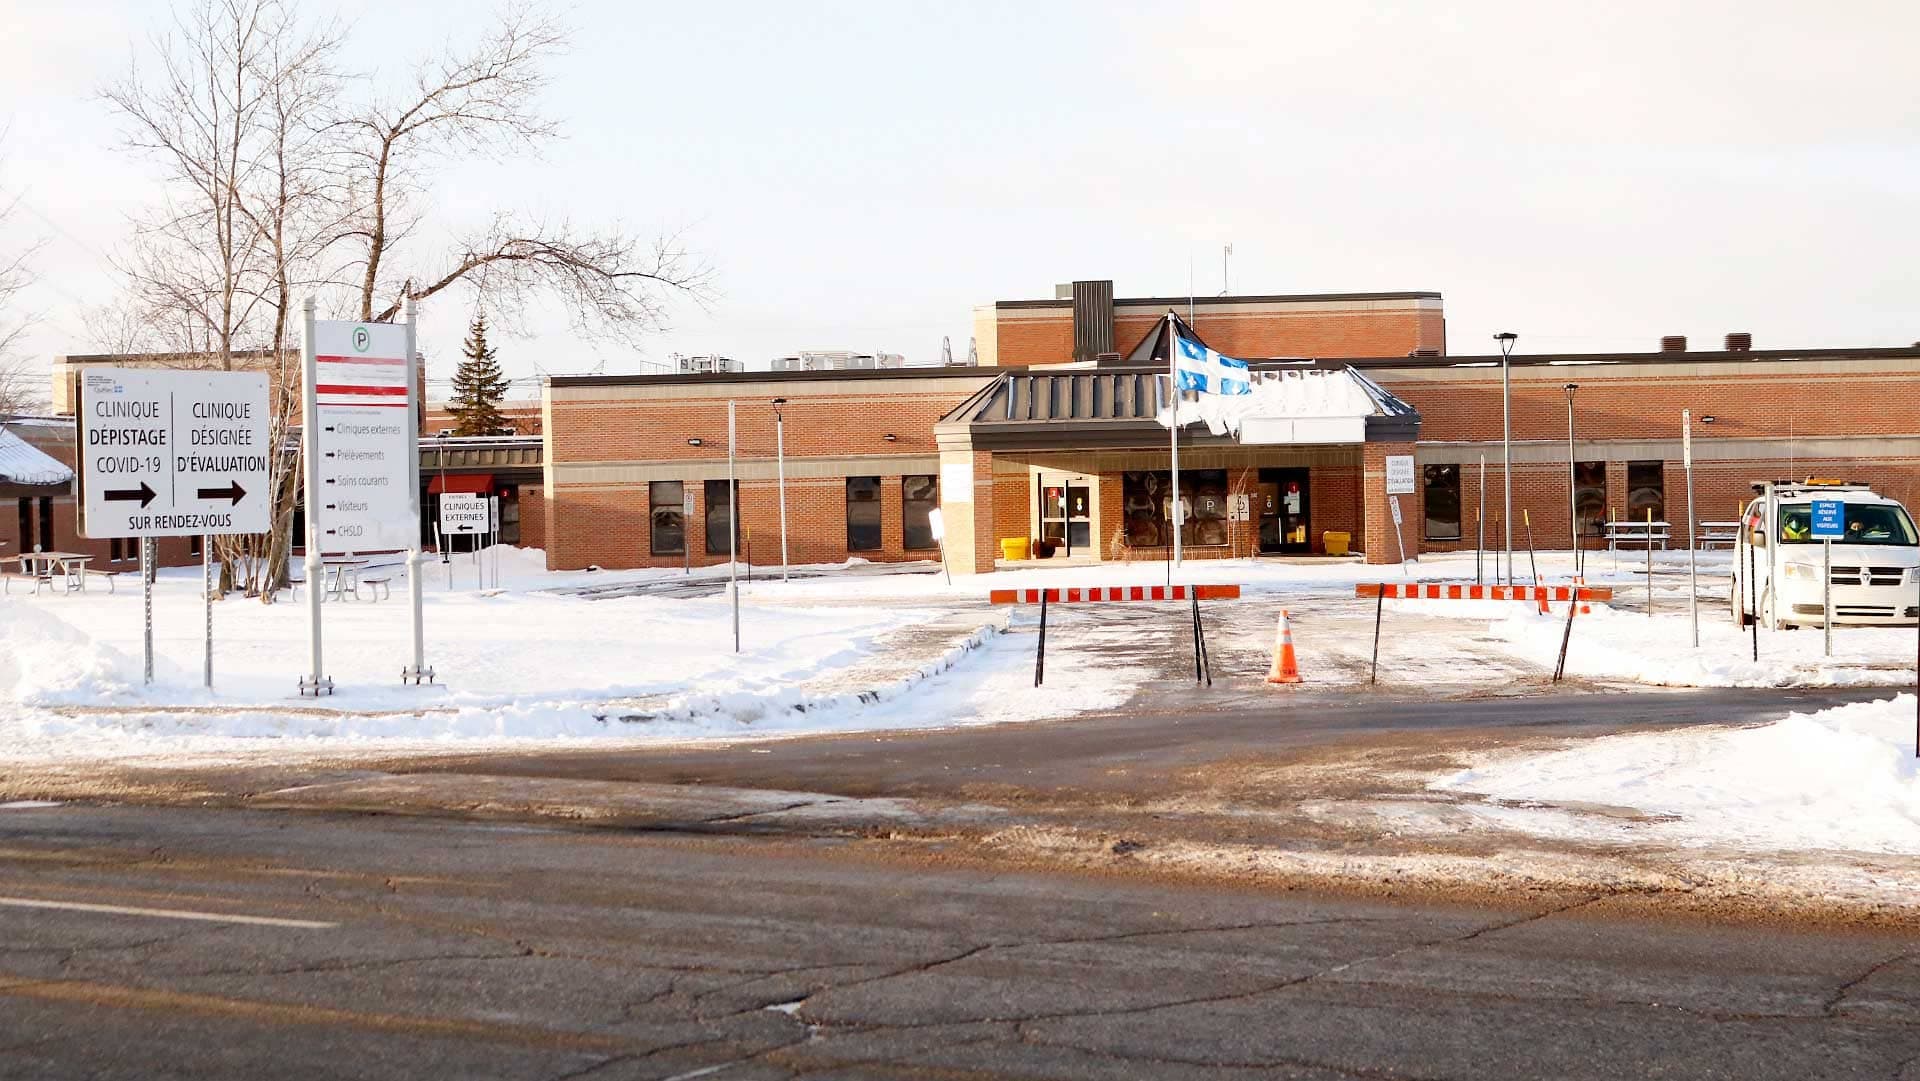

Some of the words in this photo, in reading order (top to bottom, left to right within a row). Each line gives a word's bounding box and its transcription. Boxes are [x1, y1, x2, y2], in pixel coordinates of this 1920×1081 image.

[96, 401, 160, 420] CLINIQUE
[192, 402, 251, 421] CLINIQUE
[90, 424, 166, 446] DÉPISTAGE
[191, 424, 252, 446] DÉSIGNÉE
[337, 423, 370, 435] Cliniques
[370, 425, 401, 435] externes
[97, 456, 161, 474] COVID-19
[177, 451, 266, 472] D'ÉVALUATION
[338, 475, 357, 486] Soins
[358, 476, 389, 486] courants
[338, 501, 369, 511] Visiteurs
[444, 502, 485, 511] CLINIQUES
[128, 516, 151, 530] SUR
[155, 513, 232, 529] RENDEZ-VOUS
[445, 513, 484, 521] EXTERNES
[338, 525, 363, 537] CHSLD
